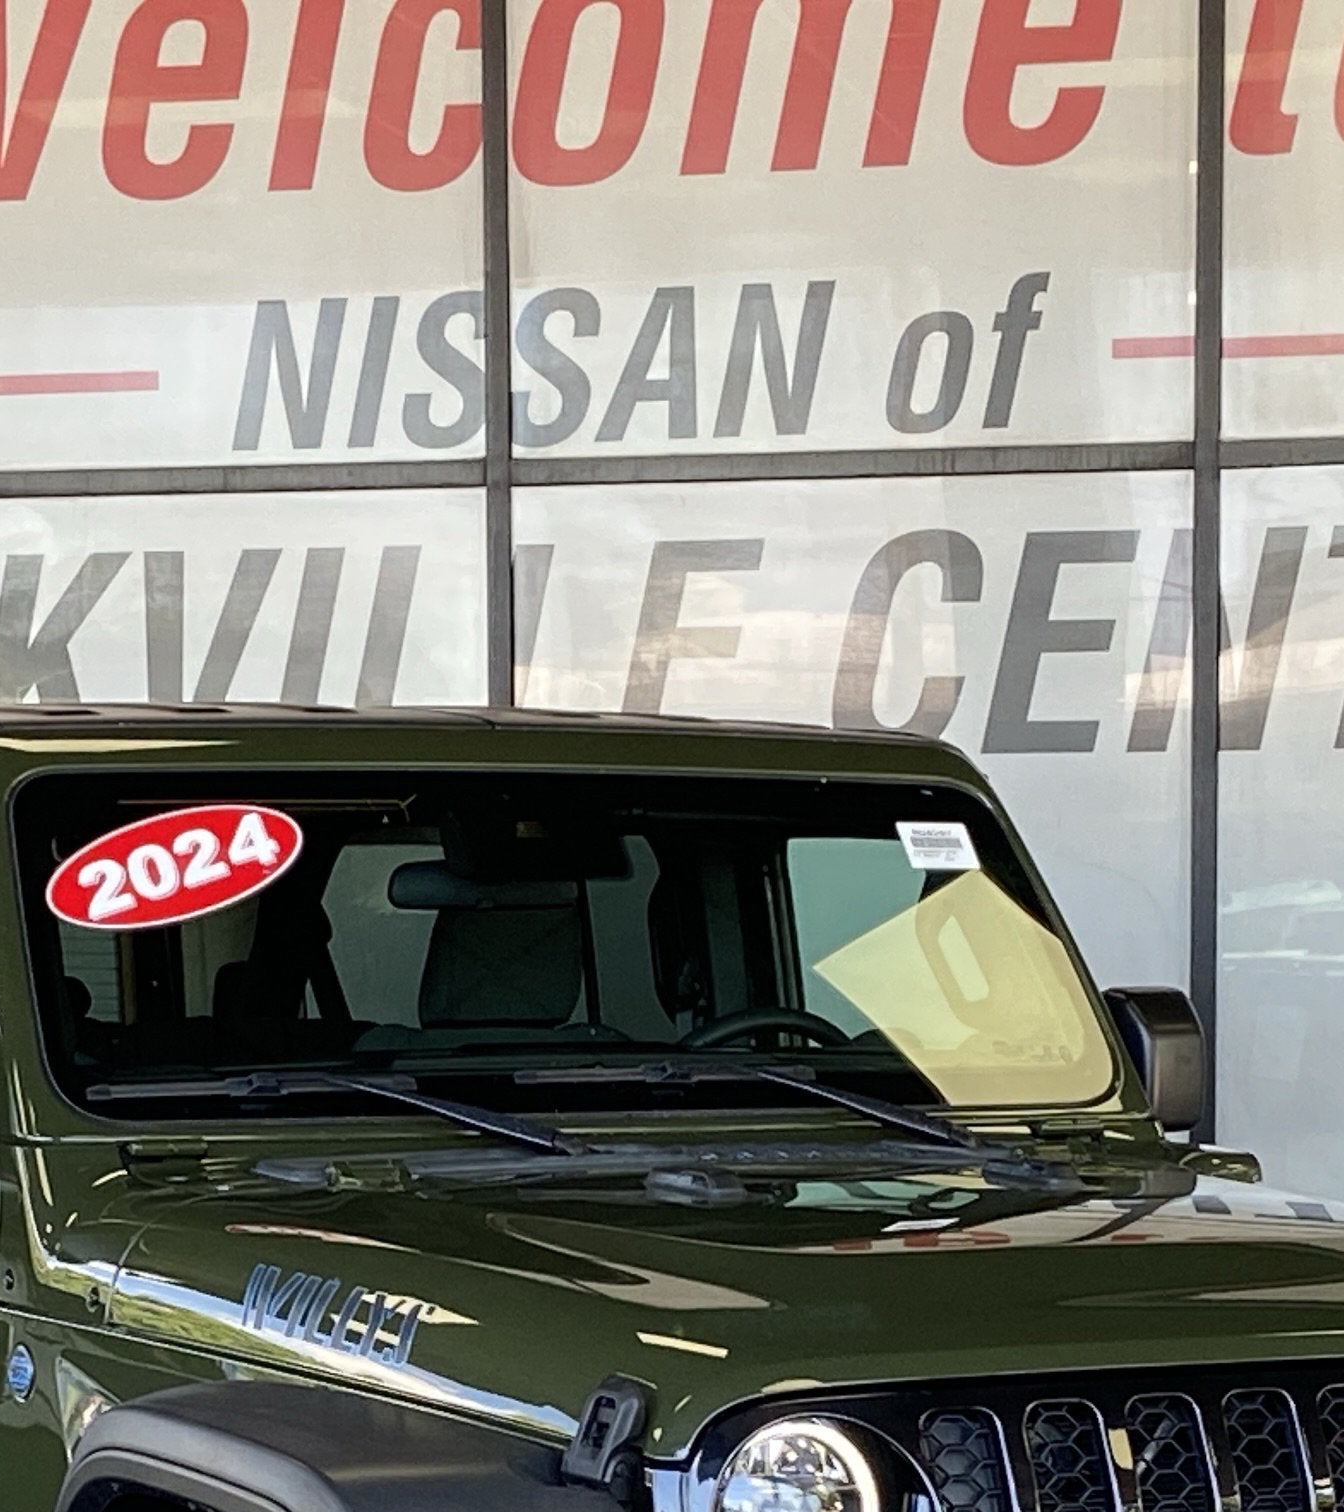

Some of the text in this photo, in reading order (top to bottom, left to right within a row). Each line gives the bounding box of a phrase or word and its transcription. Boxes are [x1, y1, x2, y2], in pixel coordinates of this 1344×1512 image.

[233, 271, 1051, 451] NISSAN of
[77, 811, 281, 921] 2024
